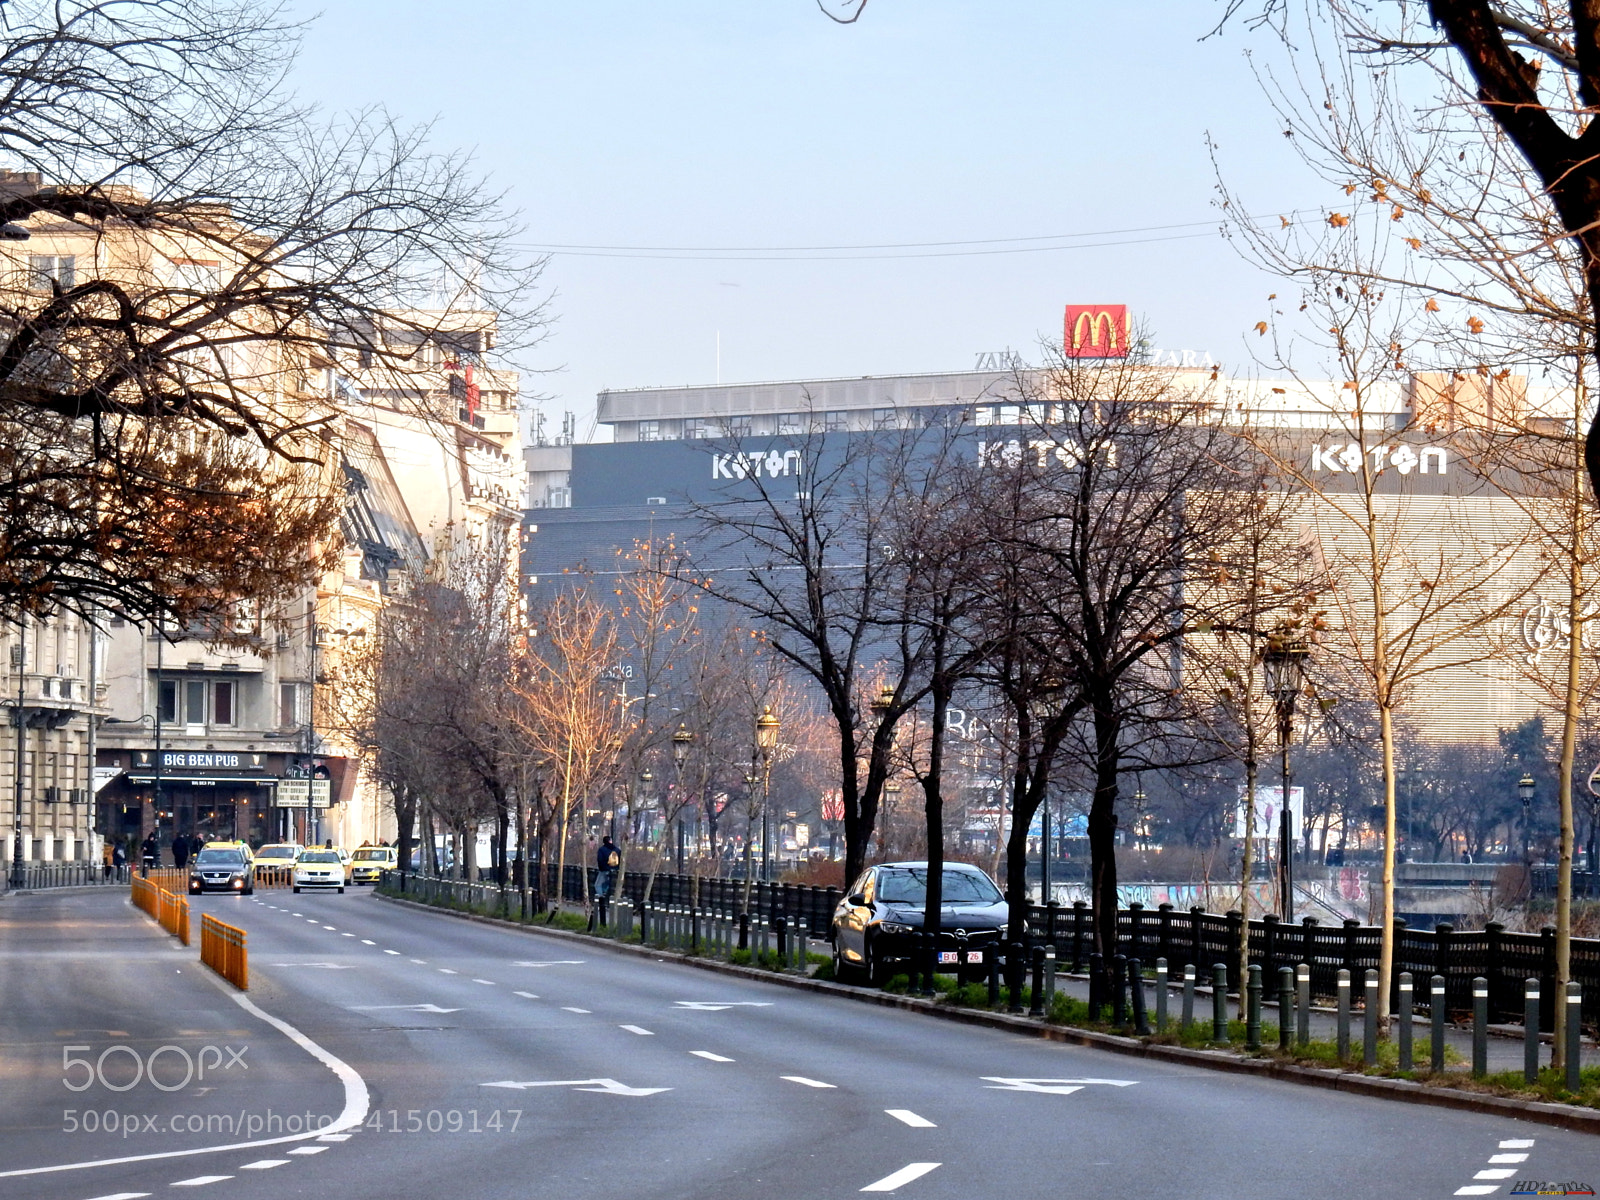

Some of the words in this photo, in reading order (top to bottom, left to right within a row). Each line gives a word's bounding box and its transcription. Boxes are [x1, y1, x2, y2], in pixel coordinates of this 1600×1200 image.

[974, 350, 1023, 370] ZARA
[1149, 348, 1216, 368] ZARA
[164, 753, 186, 766] BIG
[188, 754, 213, 767] BEN
[215, 755, 239, 767] PUB
